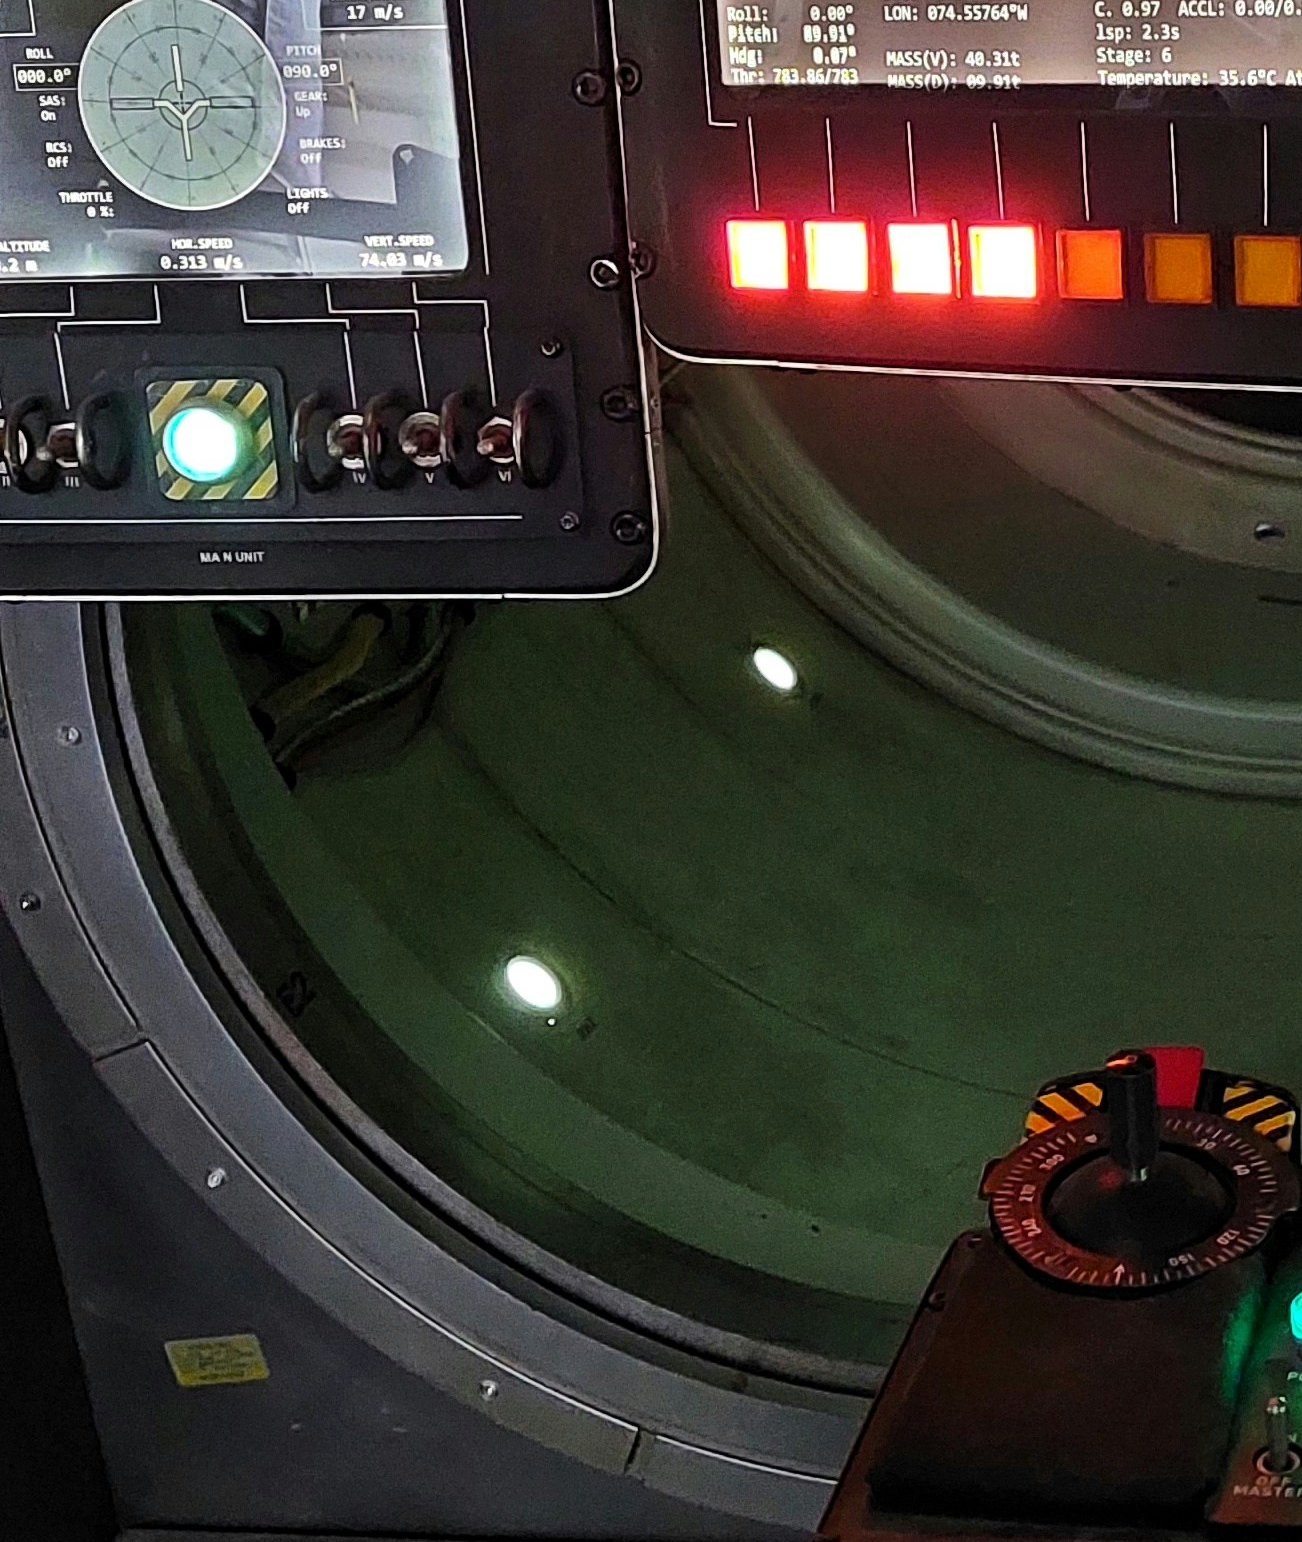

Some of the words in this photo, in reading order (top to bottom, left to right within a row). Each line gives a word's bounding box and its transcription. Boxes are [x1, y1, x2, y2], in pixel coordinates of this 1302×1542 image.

[347, 6, 366, 20] 17
[374, 5, 404, 21] m/s
[727, 6, 768, 22] Roll:
[884, 6, 918, 21] LON:
[1095, 1, 1113, 18] C.
[1122, 1, 1160, 17] 0.97
[1178, 0, 1225, 17] ACCL:
[26, 48, 53, 59] ROLL
[886, 50, 957, 69] MASS(V):
[965, 50, 1020, 67] 40.31t
[1098, 70, 1208, 87] Temperature:
[40, 110, 56, 121] On
[59, 192, 113, 203] THROTTLE
[286, 188, 328, 199] LIGHTS
[288, 203, 309, 214] Off
[160, 256, 208, 270] 0.313
[425, 473, 435, 484] V
[234, 551, 264, 563] UNIT
